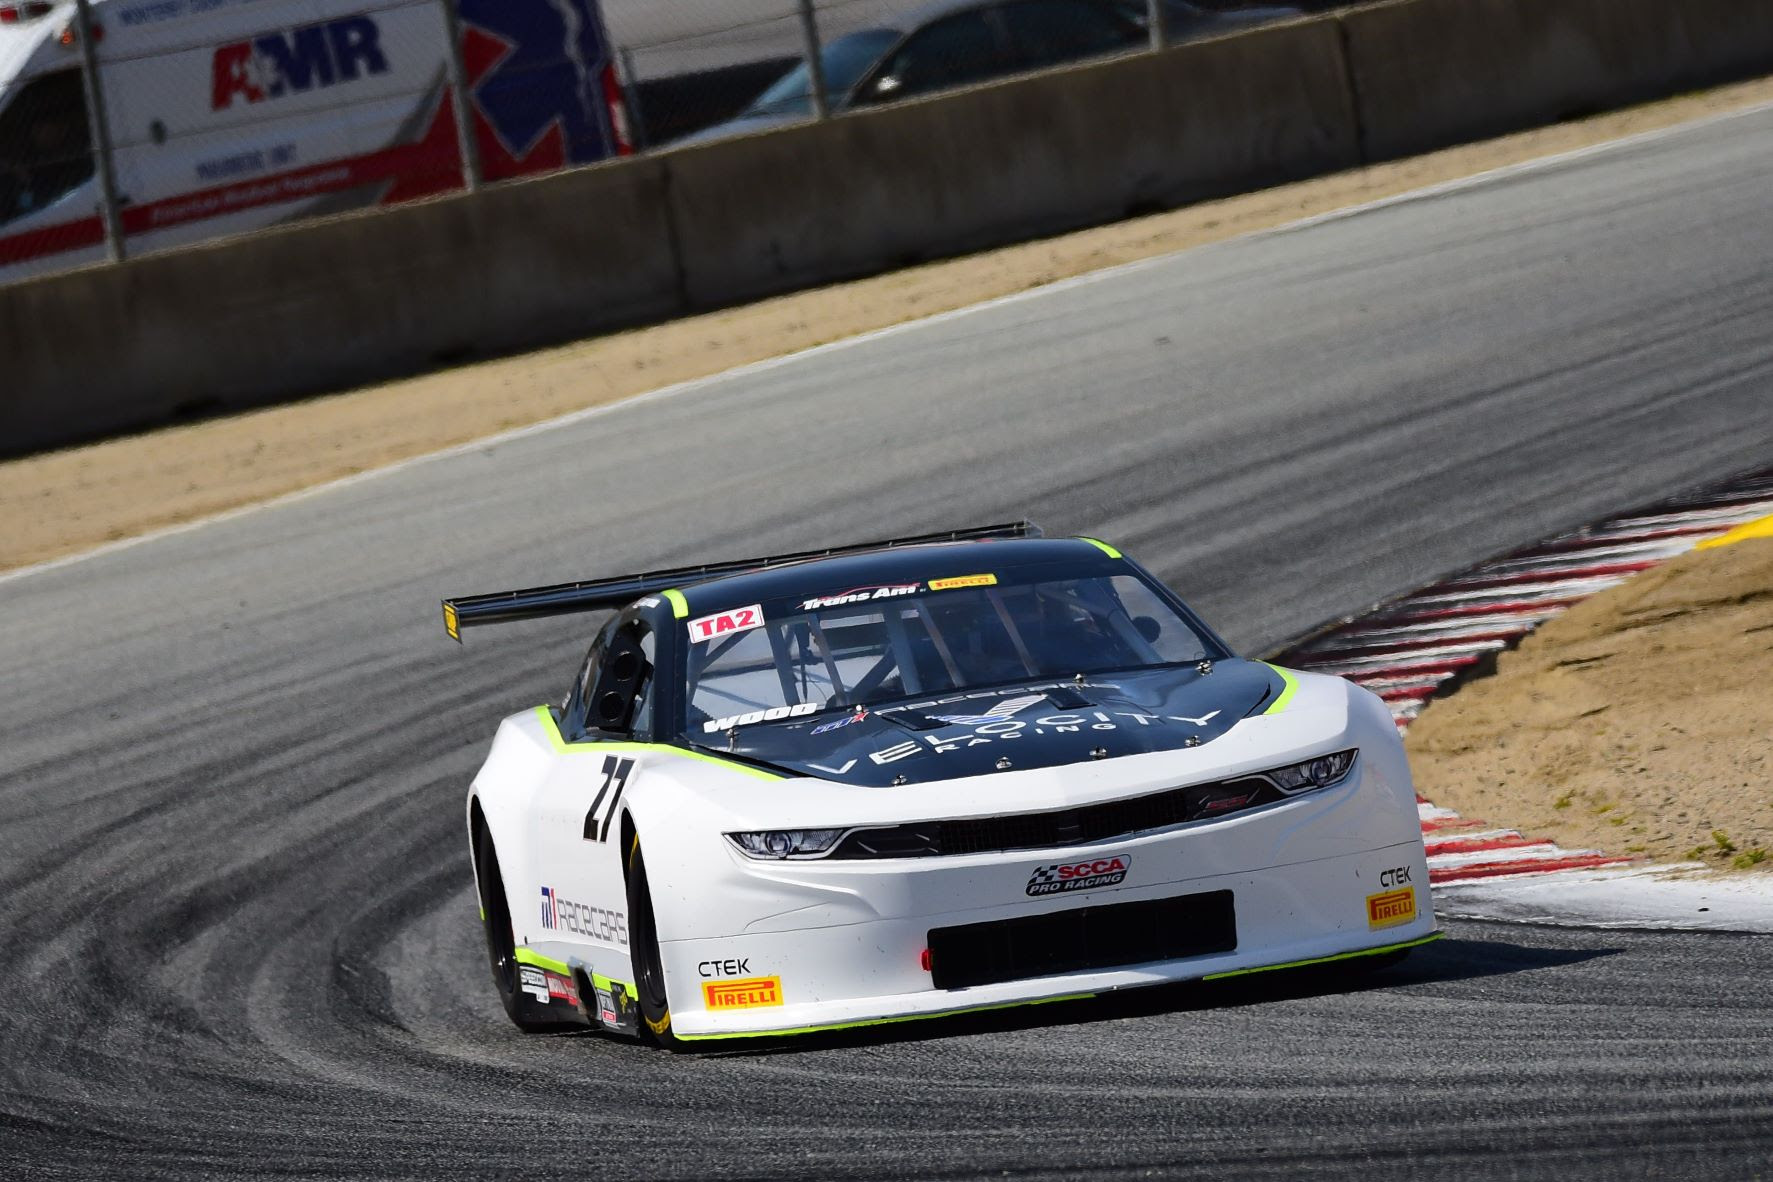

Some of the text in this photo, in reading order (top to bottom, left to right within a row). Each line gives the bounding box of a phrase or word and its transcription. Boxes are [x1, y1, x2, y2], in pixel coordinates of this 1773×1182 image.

[210, 15, 391, 111] AMR
[802, 584, 917, 611] Trans Am
[696, 608, 756, 637] TA2
[703, 702, 818, 734] WOOD
[806, 709, 1222, 775] VELOCITY
[935, 722, 1117, 754] RACING
[583, 753, 637, 844] 27
[1057, 857, 1126, 880] SCCA
[1380, 865, 1412, 888] CTEK
[1028, 873, 1122, 894] PRO RACING
[1369, 891, 1413, 921] PIRELLI
[697, 957, 752, 978] CTEK
[706, 980, 777, 1007] PIRELLI
